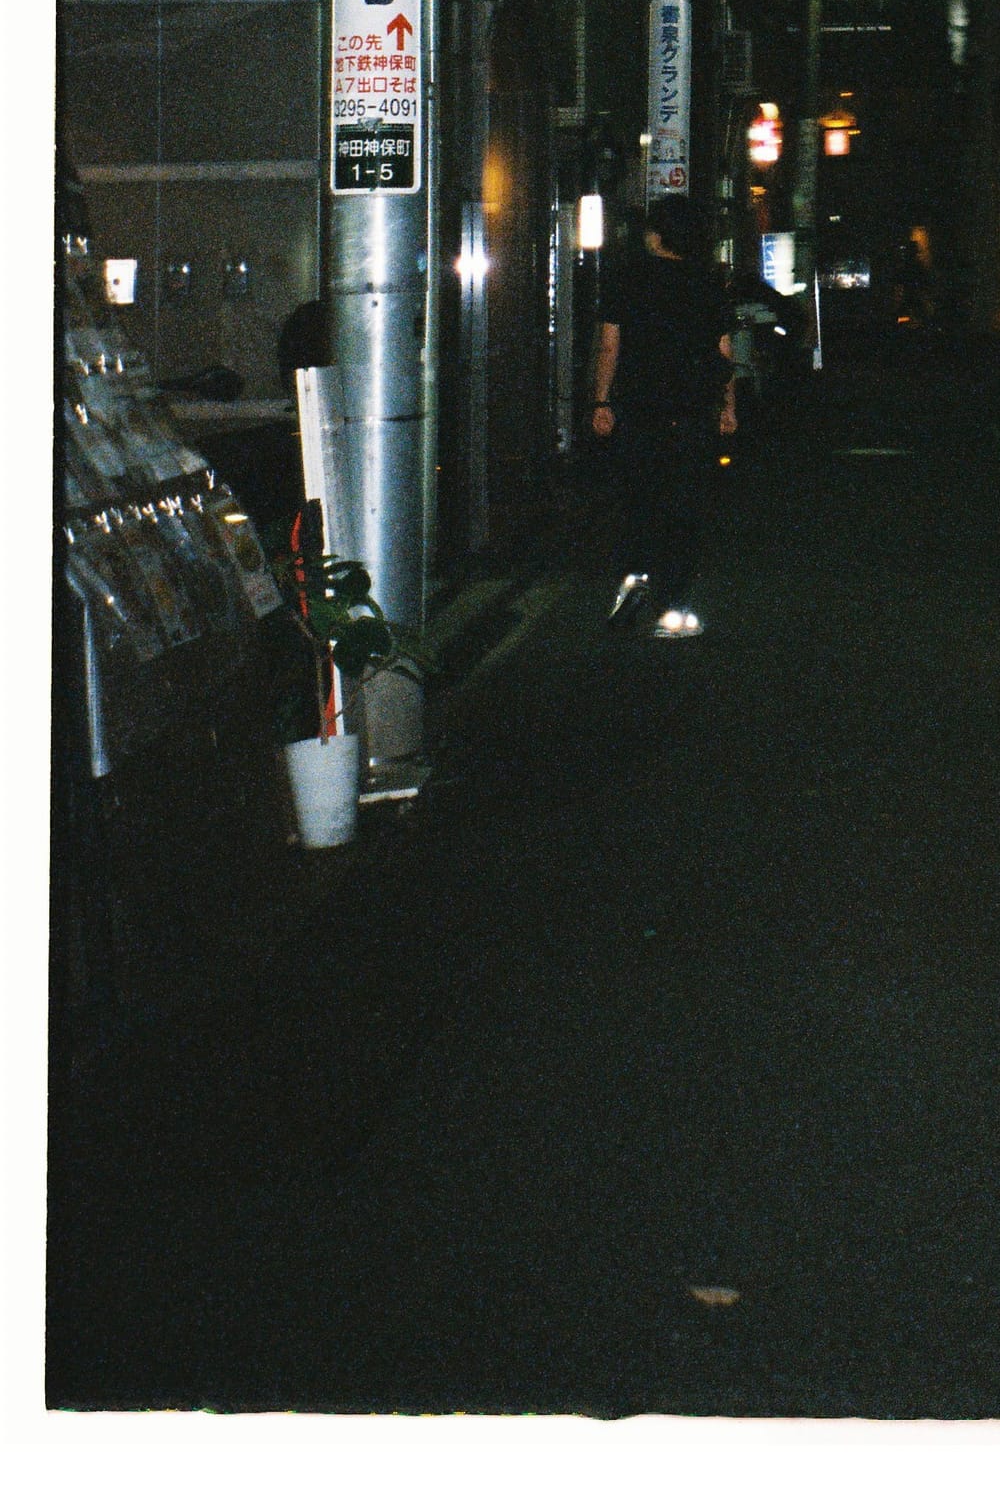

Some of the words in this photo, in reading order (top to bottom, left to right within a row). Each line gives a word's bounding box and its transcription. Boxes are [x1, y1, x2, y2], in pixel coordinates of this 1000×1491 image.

[337, 34, 383, 52] この先
[338, 138, 411, 158] 神田神保町
[352, 163, 393, 181] 1-5
